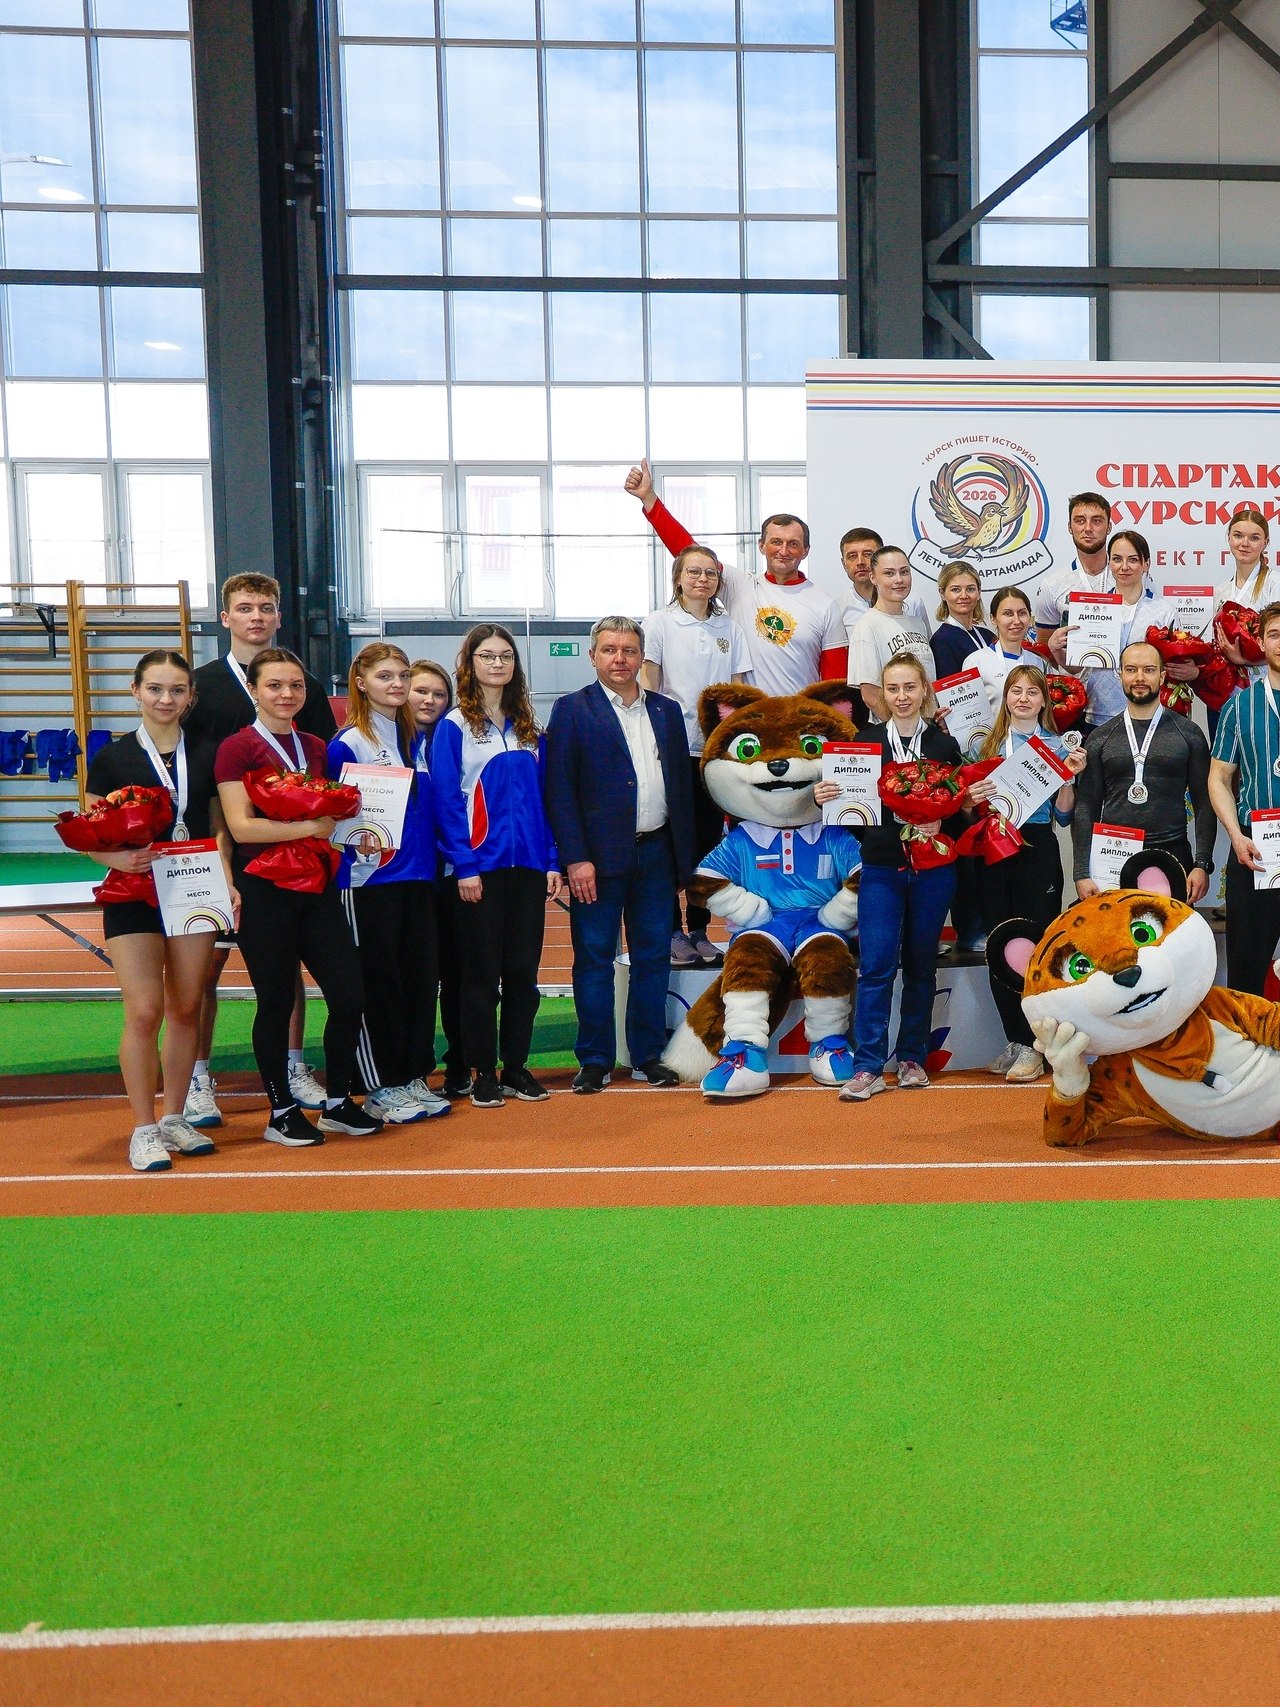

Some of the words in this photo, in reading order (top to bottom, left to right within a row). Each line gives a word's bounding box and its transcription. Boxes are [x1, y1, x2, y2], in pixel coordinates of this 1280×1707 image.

[925, 441, 954, 463] КУРСК
[955, 435, 990, 446] ПИШЕТ
[992, 437, 1036, 463] ИСТОРИЮ
[962, 490, 997, 501] 2026
[917, 550, 946, 569] ЛЕТН
[978, 551, 1044, 578] АРТАКИАДА
[1156, 550, 1205, 566] ЕКТ
[1078, 613, 1112, 621] ДИПЛОМ
[888, 634, 905, 656] LOS
[949, 691, 979, 708] ДИПЛОМ
[965, 711, 981, 720] МЕСТО
[834, 766, 871, 774] ДИПЛОМ
[1021, 760, 1049, 788] ДИПЛОМ
[359, 786, 394, 795] ИПЛОМ
[1016, 782, 1031, 798] МЕСТО
[1100, 847, 1133, 857] ДИПЛОМ
[166, 866, 211, 879] ДИПЛОМ
[187, 890, 211, 898] МЕСТО
